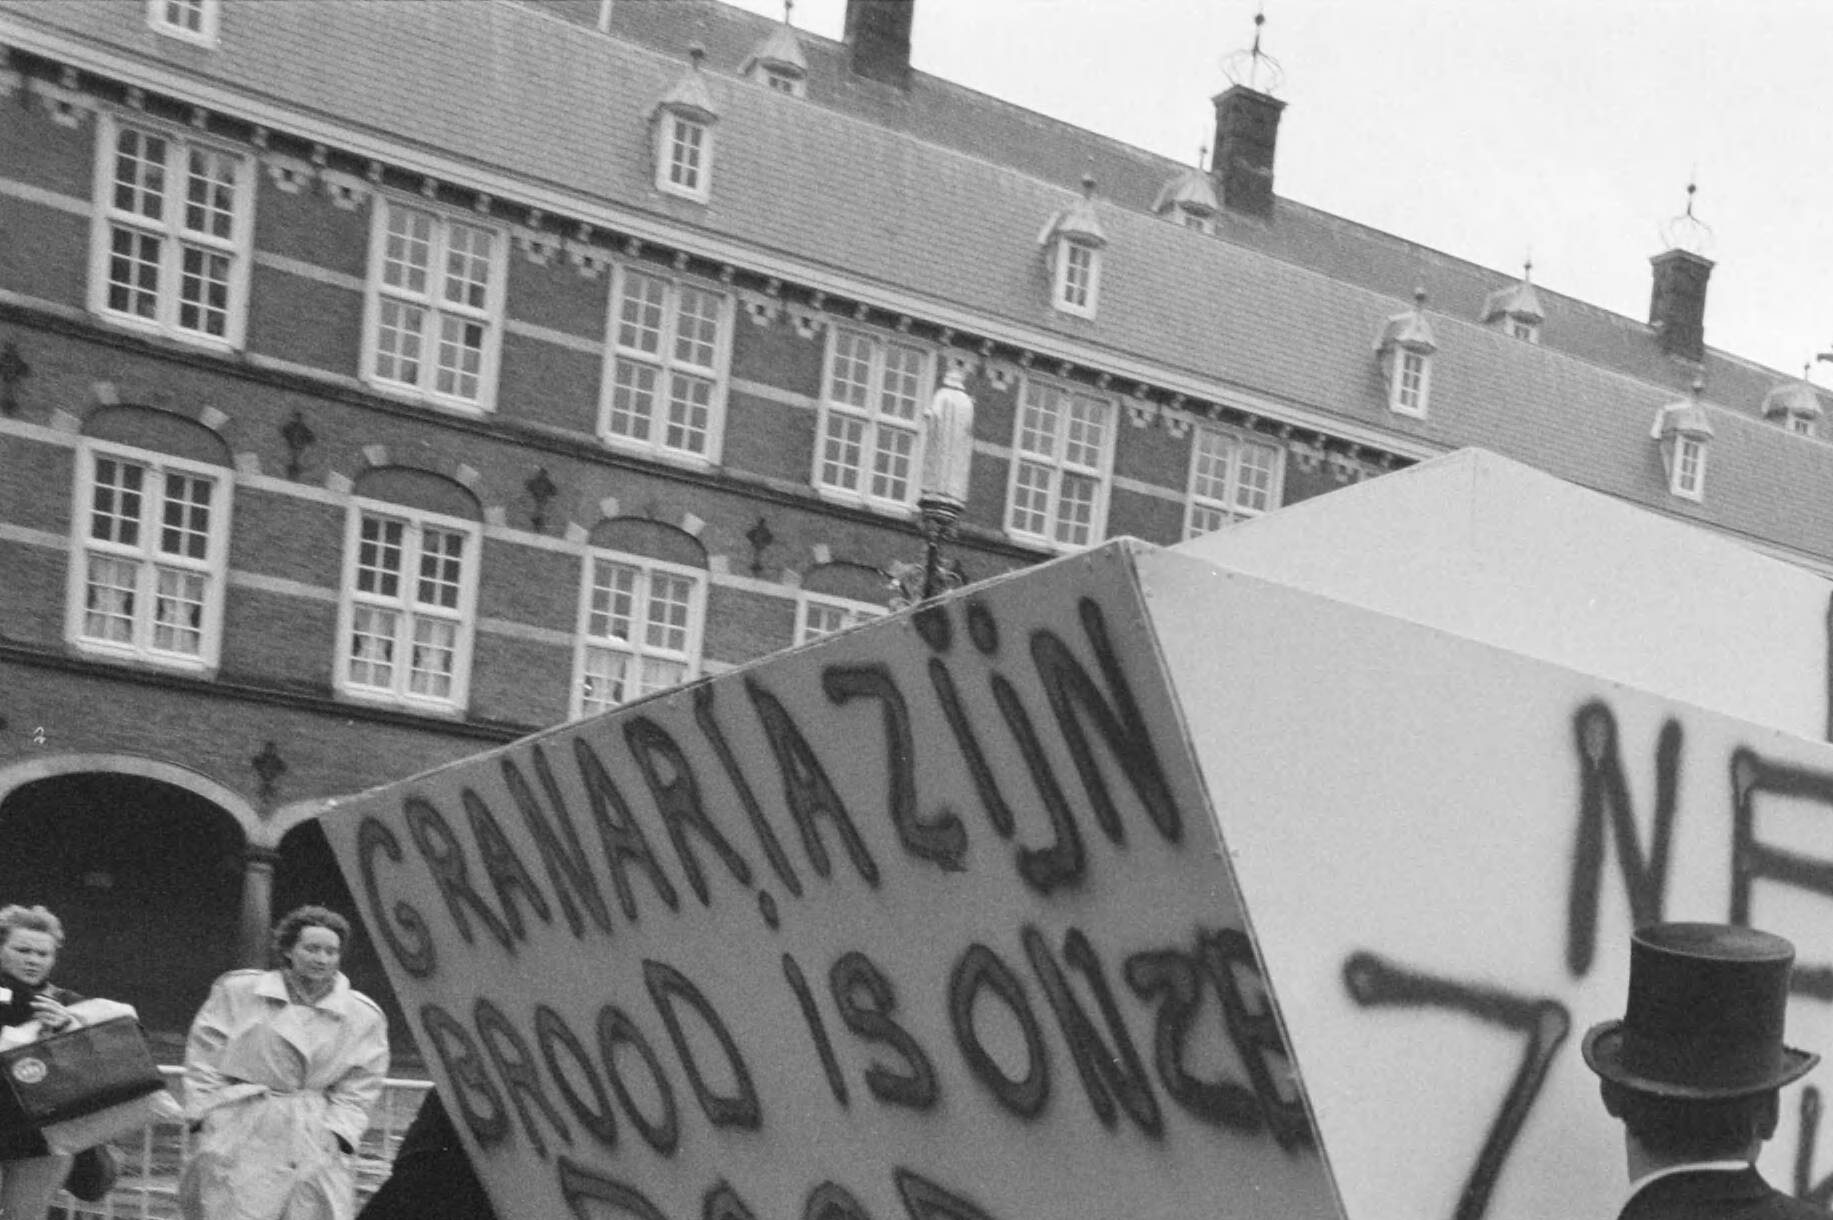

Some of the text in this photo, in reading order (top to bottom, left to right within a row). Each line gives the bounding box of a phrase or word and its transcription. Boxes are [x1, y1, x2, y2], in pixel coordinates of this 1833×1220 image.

[357, 676, 879, 980] GRANARIA
[420, 890, 1317, 1160] BROOD IS ONZE
